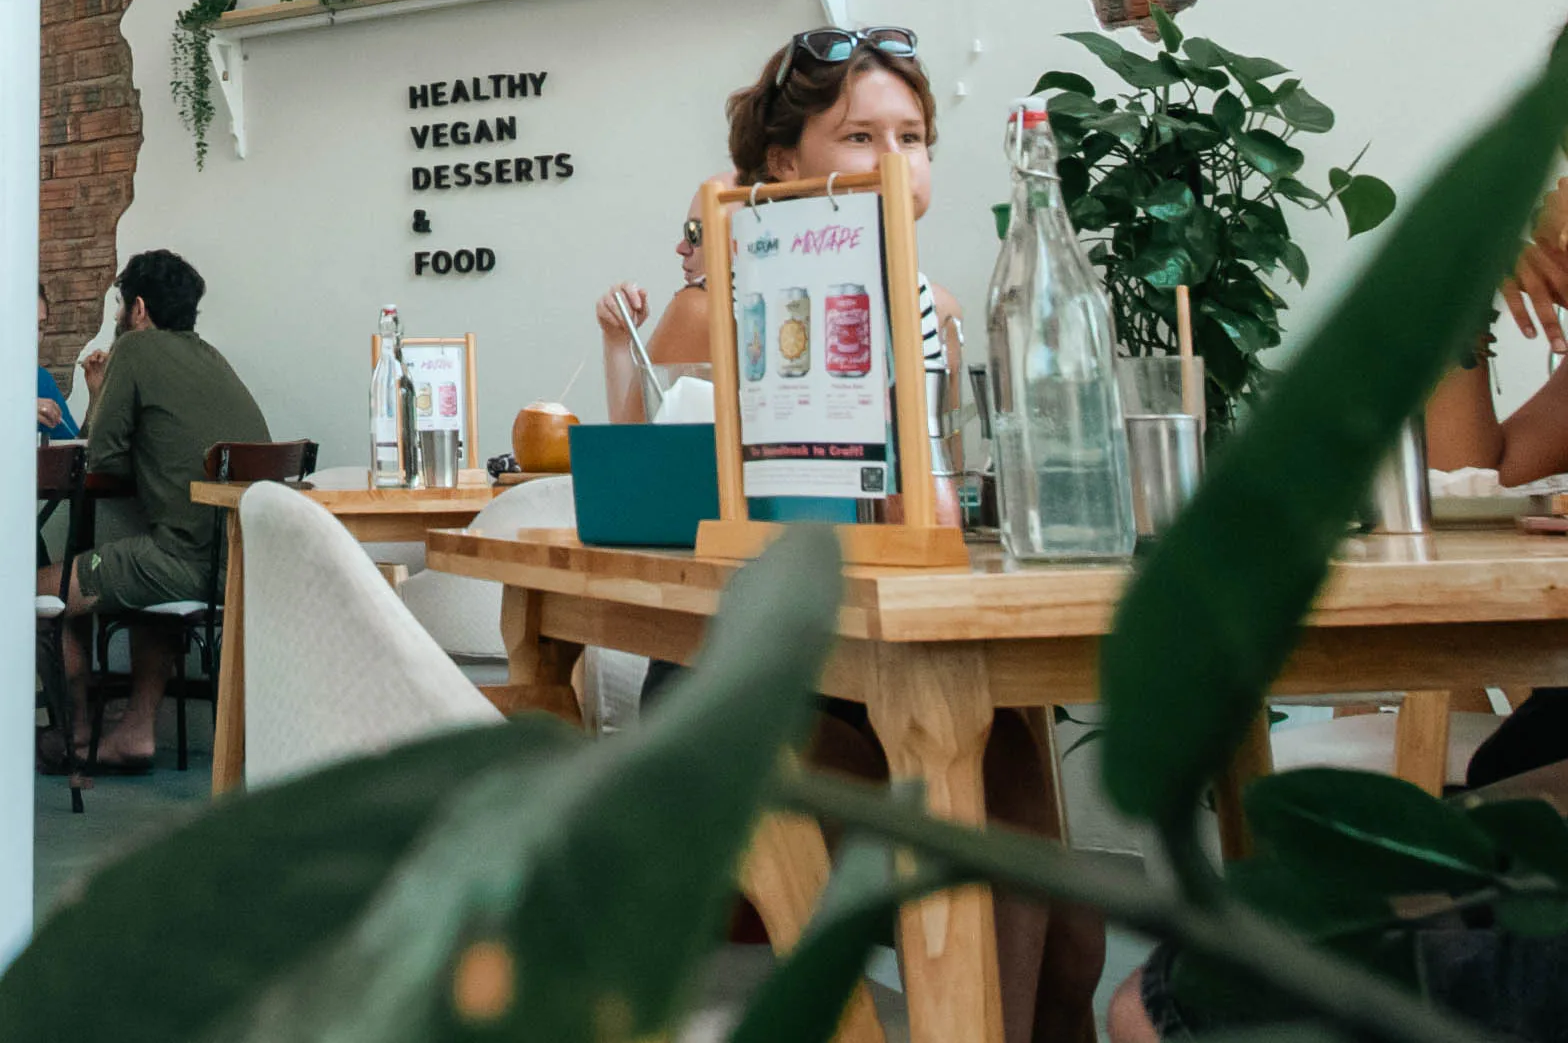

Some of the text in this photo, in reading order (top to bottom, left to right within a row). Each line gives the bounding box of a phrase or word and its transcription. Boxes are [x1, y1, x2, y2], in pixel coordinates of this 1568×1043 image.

[408, 71, 548, 110] HEALTHY
[410, 116, 517, 149] VEGAN
[412, 153, 574, 191] DESSERTS
[412, 209, 432, 234] &
[414, 247, 496, 276] FOOD
